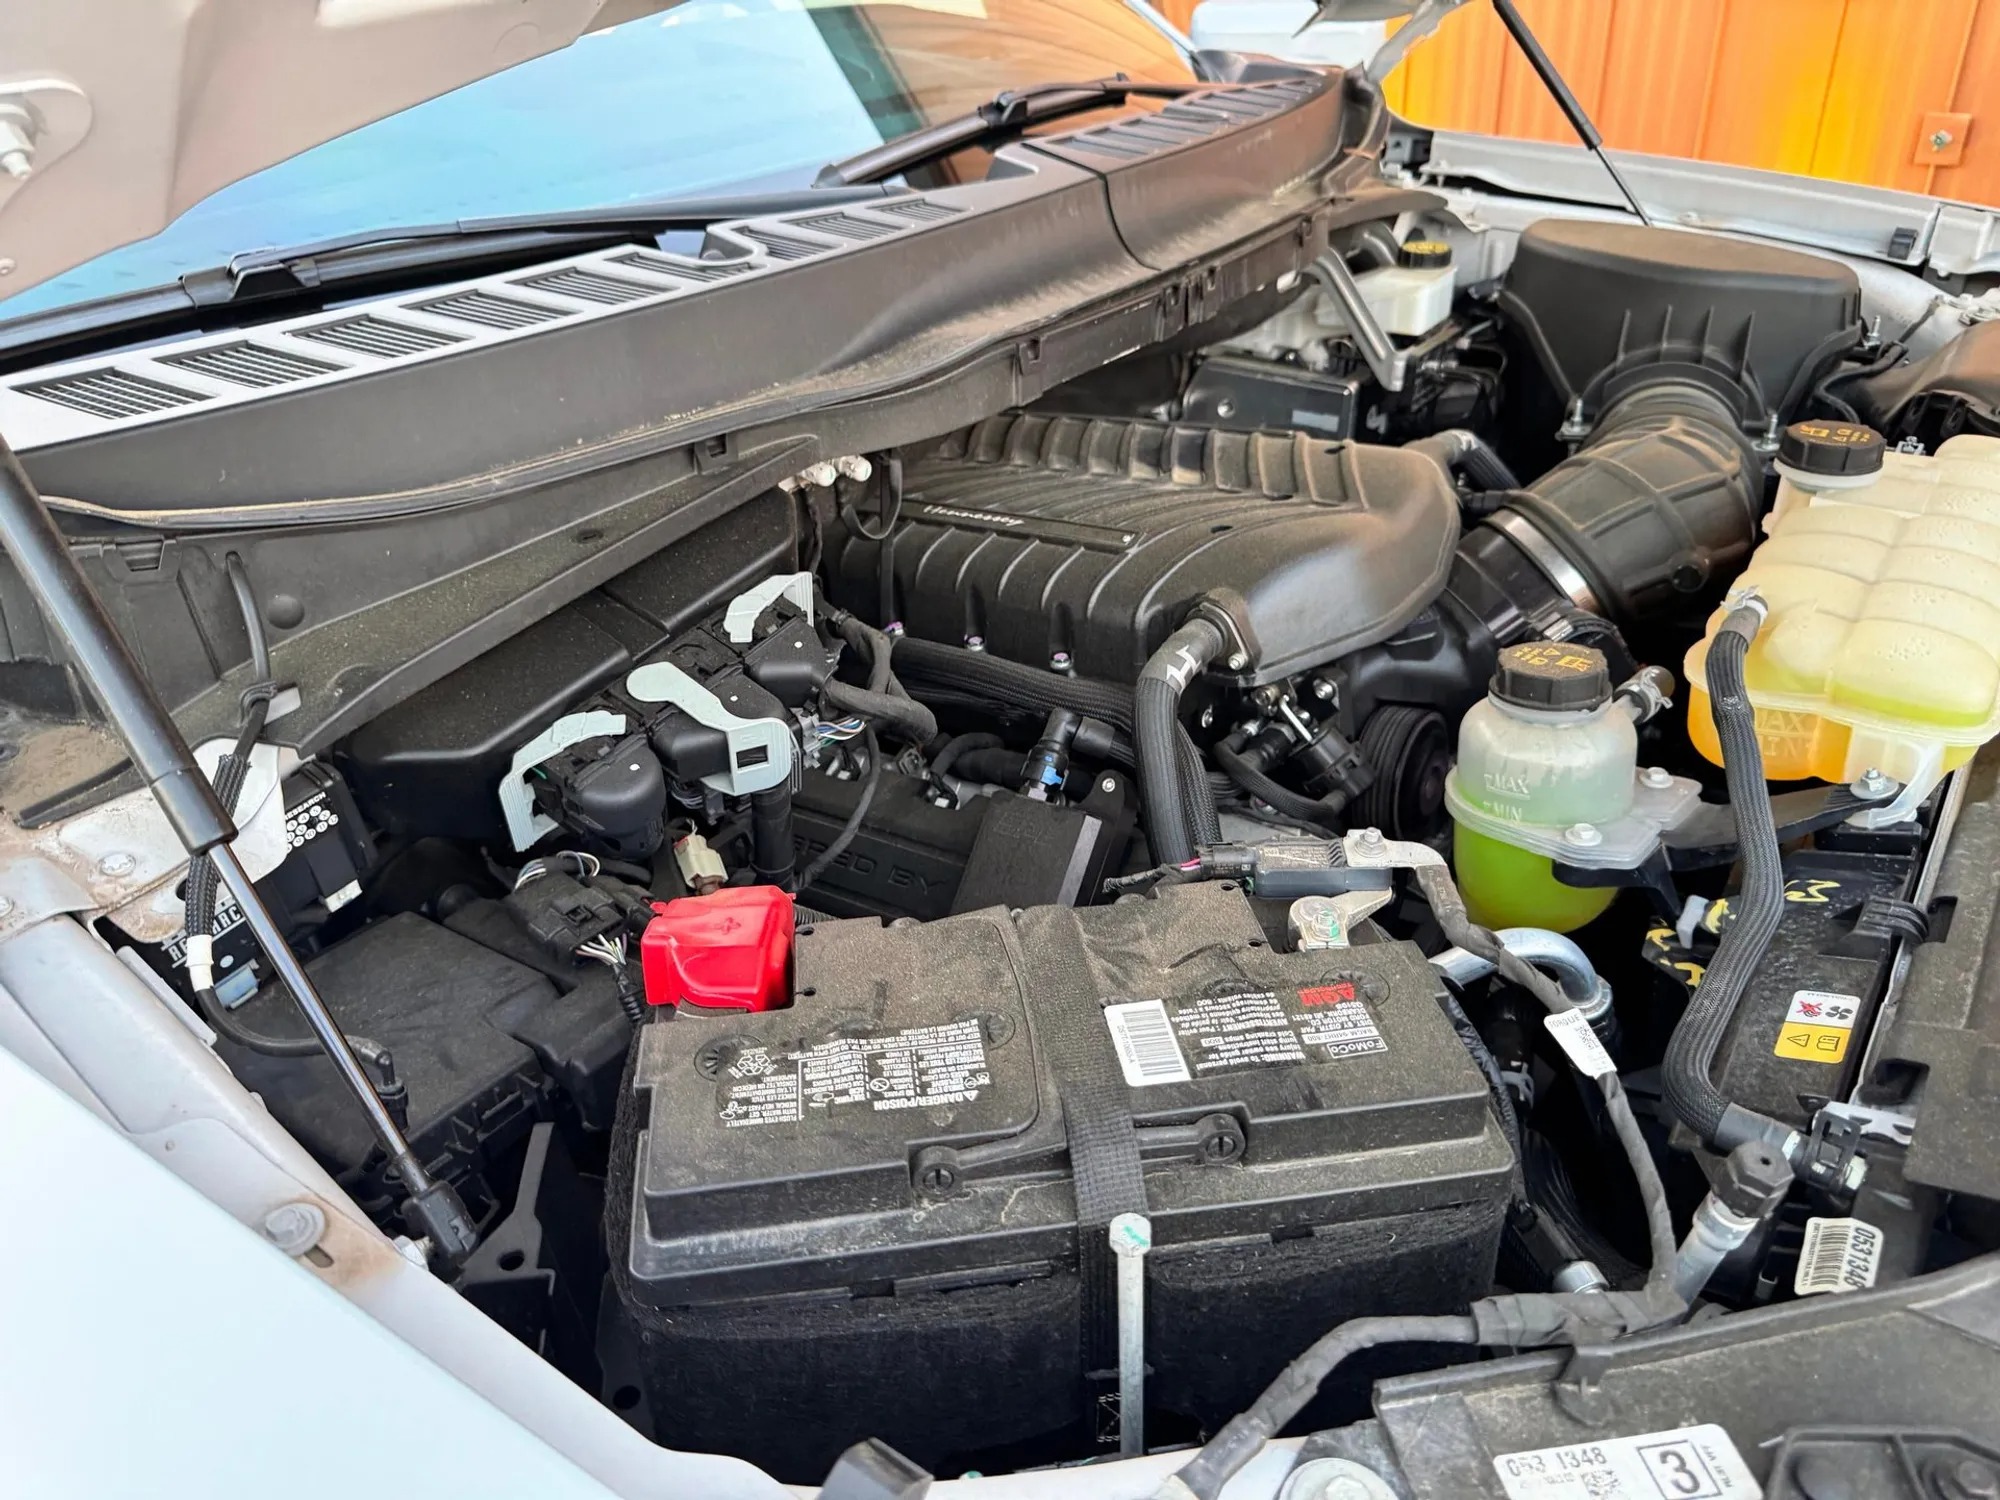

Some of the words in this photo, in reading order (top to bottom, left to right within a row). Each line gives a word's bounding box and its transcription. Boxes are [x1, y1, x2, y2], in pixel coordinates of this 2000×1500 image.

[923, 504, 1024, 526] Hennessey
[887, 864, 949, 899] BY
[1300, 988, 1355, 1006] AGM
[1321, 1016, 1348, 1024] MOTOR
[1350, 1013, 1369, 1021] FORD
[970, 1018, 978, 1026] NE
[1191, 1019, 1210, 1027] guide
[1222, 1017, 1288, 1032] AVERTISSEMENT
[1245, 1031, 1276, 1040] cranking
[847, 1038, 859, 1047] PAS
[1260, 1038, 1278, 1046] start
[1331, 1040, 1383, 1053] FoMoCo
[1220, 1049, 1241, 1058] guide
[1242, 1046, 1264, 1055] owner
[1229, 1056, 1250, 1065] avoid
[1260, 1051, 1306, 1062] WARNING:
[1196, 1059, 1228, 1070] personal
[833, 1075, 854, 1084] SEVERE
[766, 1080, 797, 1089] CONSULTEZ
[834, 1082, 852, 1090] CAUSE
[849, 1087, 864, 1095] ACID
[927, 1087, 942, 1095] EYES
[873, 1093, 964, 1111] DANGER/POISON
[726, 1118, 763, 1127] IMMEDIATELY
[1557, 1447, 1607, 1469] 1348
[1659, 1451, 1699, 1495] 3
